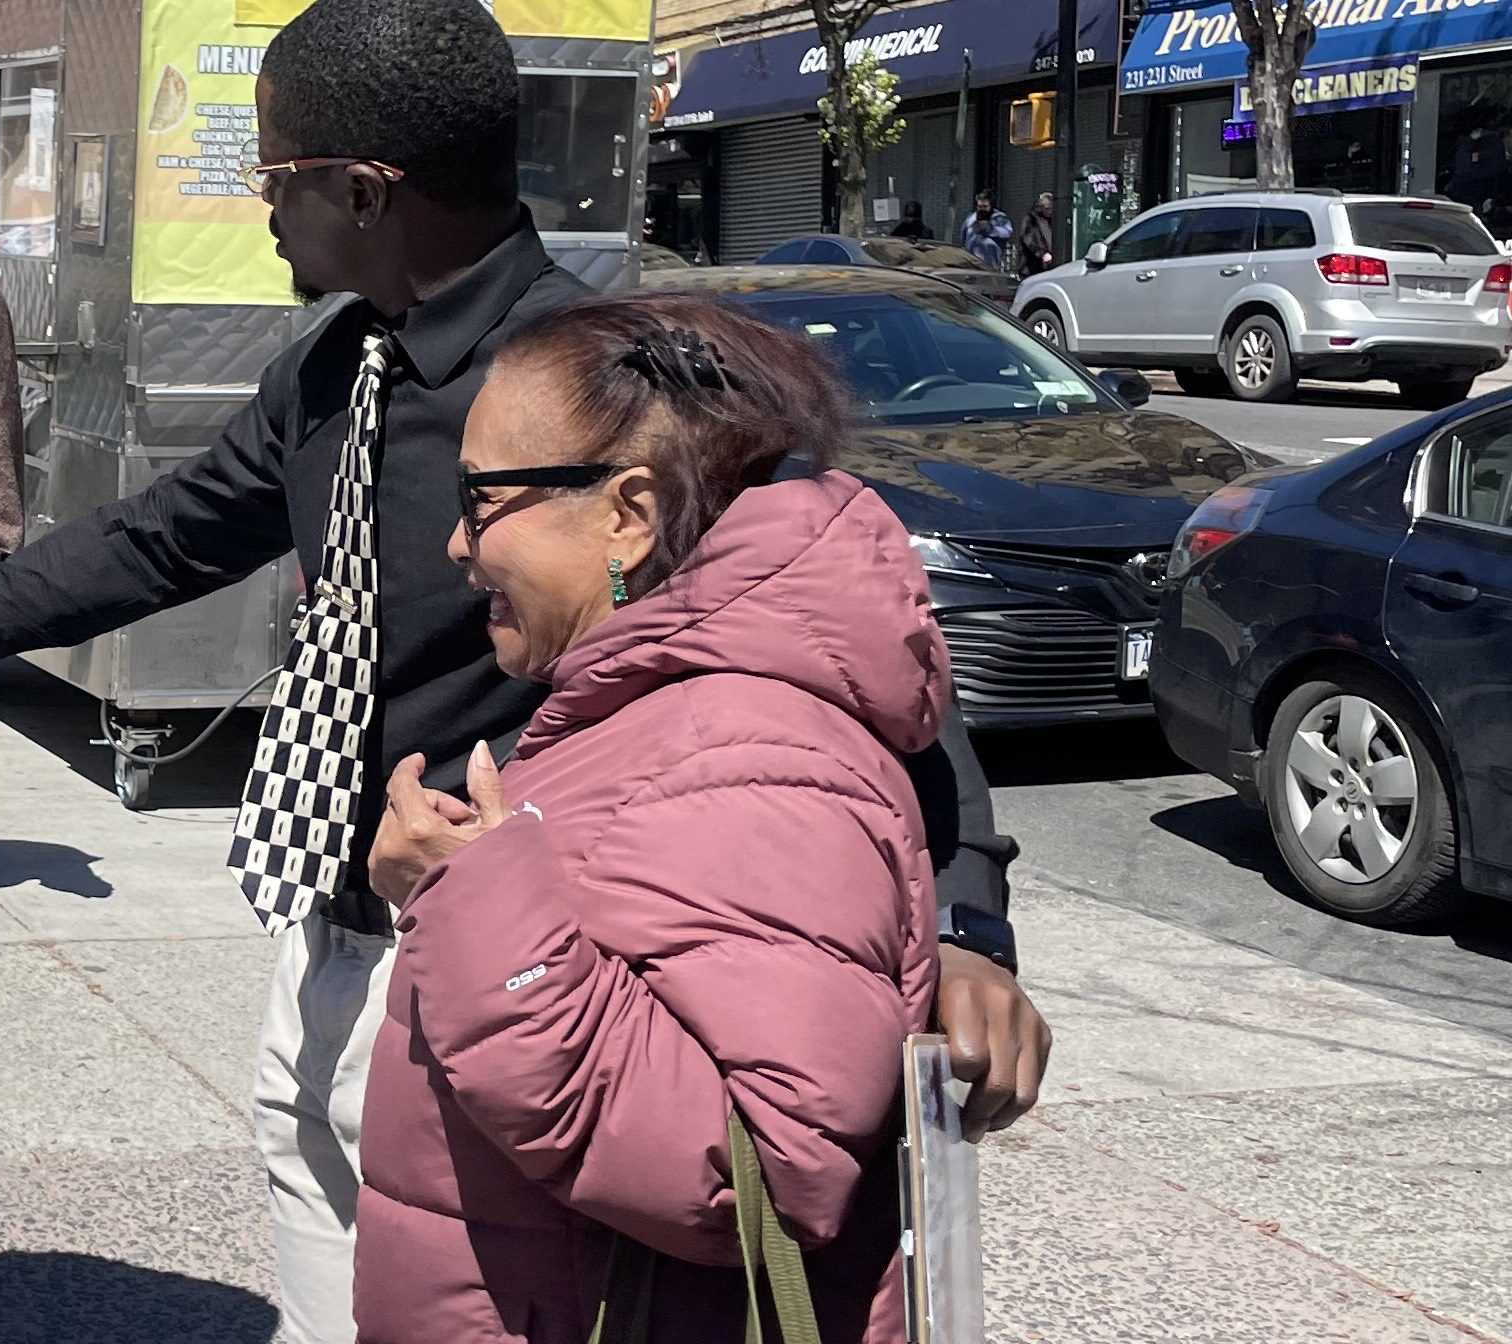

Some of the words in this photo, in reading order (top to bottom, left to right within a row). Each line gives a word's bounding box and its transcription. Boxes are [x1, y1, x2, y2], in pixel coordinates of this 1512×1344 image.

[199, 45, 267, 75] MENU
[1168, 62, 1204, 81] Street
[1291, 64, 1417, 105] CLEANERS
